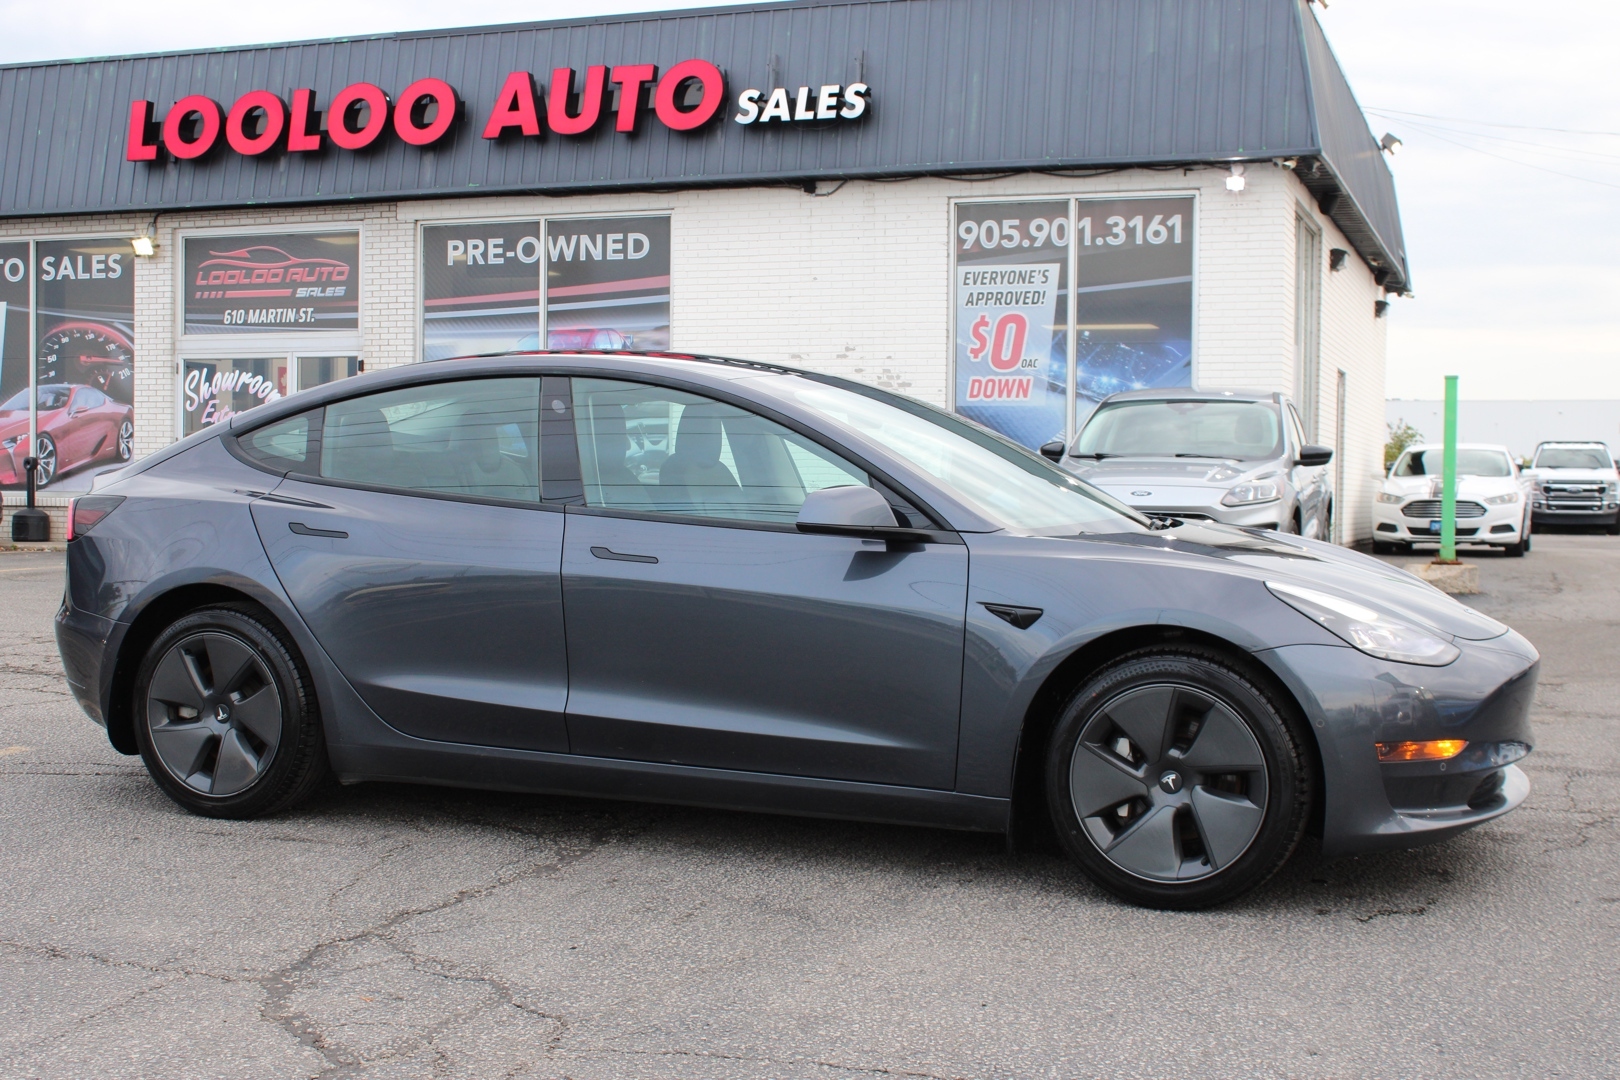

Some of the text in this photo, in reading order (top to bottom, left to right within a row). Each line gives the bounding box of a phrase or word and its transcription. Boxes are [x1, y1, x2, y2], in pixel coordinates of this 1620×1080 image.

[126, 58, 869, 162] LOOLOO AUTO SALES
[957, 214, 1183, 250] 905.901.3161
[447, 231, 650, 267] PRE-OWNED
[0, 253, 122, 282] O SALES
[195, 266, 350, 286] LOOLOO AUTO
[962, 268, 1050, 286] EVERYONE'S
[295, 286, 347, 298] SALES
[965, 290, 1047, 307] APPROVED!
[223, 307, 316, 325] 610 MARTIN ST.
[968, 313, 1039, 371] $0 OAC
[47, 354, 57, 363] 50
[118, 367, 131, 380] 210
[968, 378, 1032, 399] DOWN
